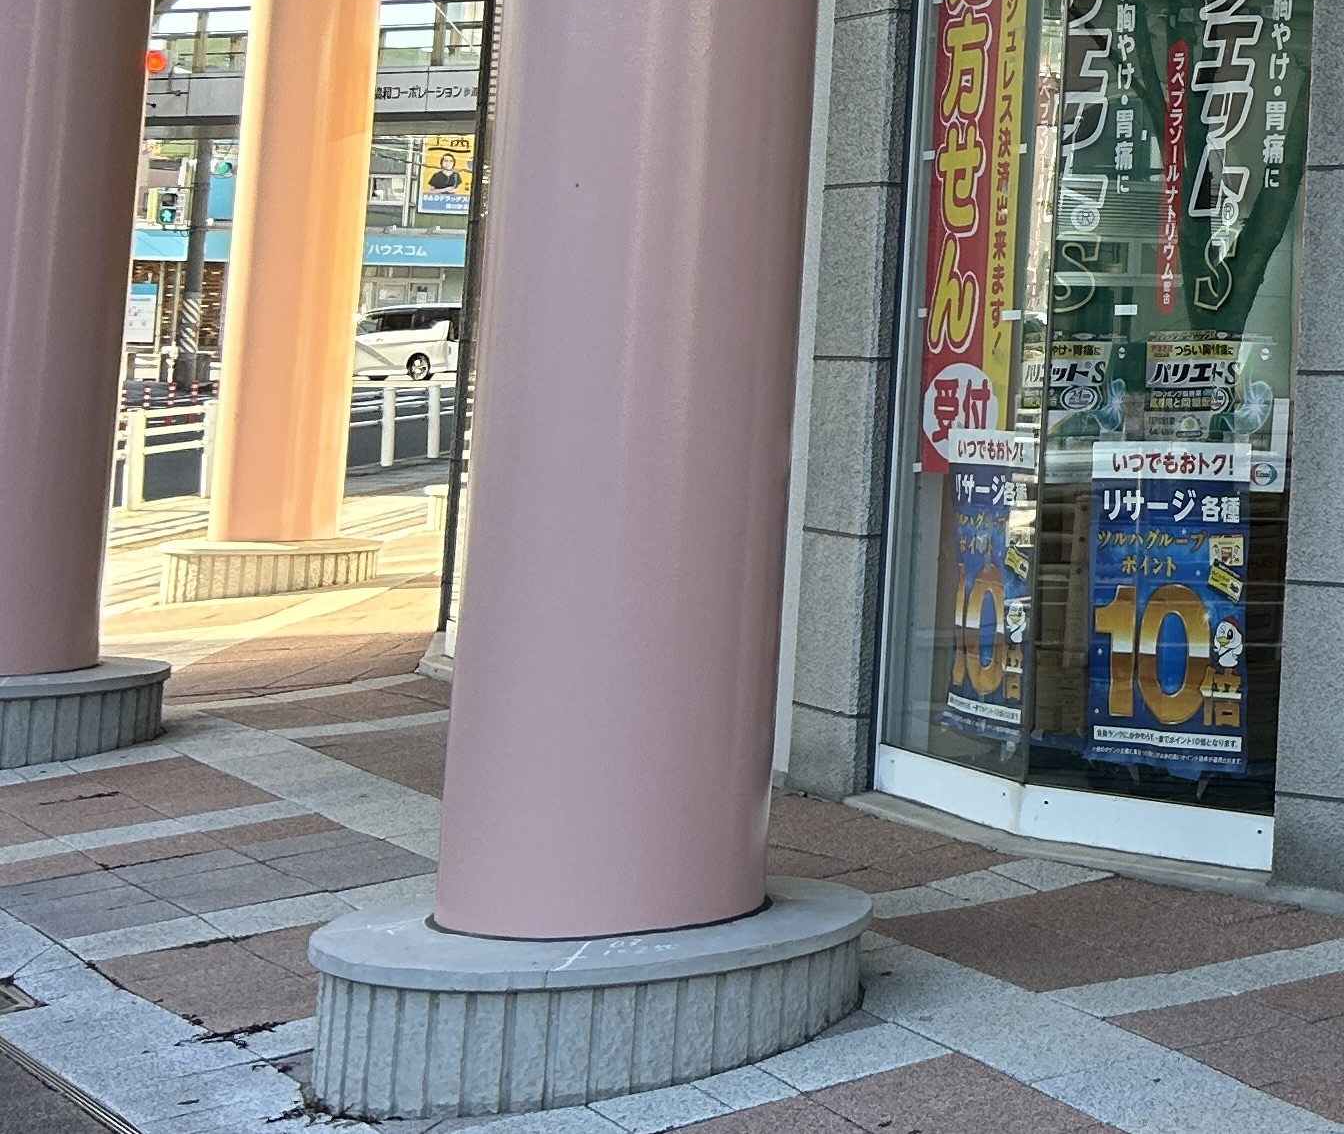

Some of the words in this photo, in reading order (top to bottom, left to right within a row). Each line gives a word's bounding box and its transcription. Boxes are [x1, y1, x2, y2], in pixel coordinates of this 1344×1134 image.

[368, 245, 428, 258] ハウスコム
[930, 379, 991, 443] 受付
[1112, 452, 1234, 476] いつでもおトク!
[1103, 489, 1196, 522] リサージ
[1201, 496, 1240, 524] 各種
[1121, 555, 1177, 578] ポイント
